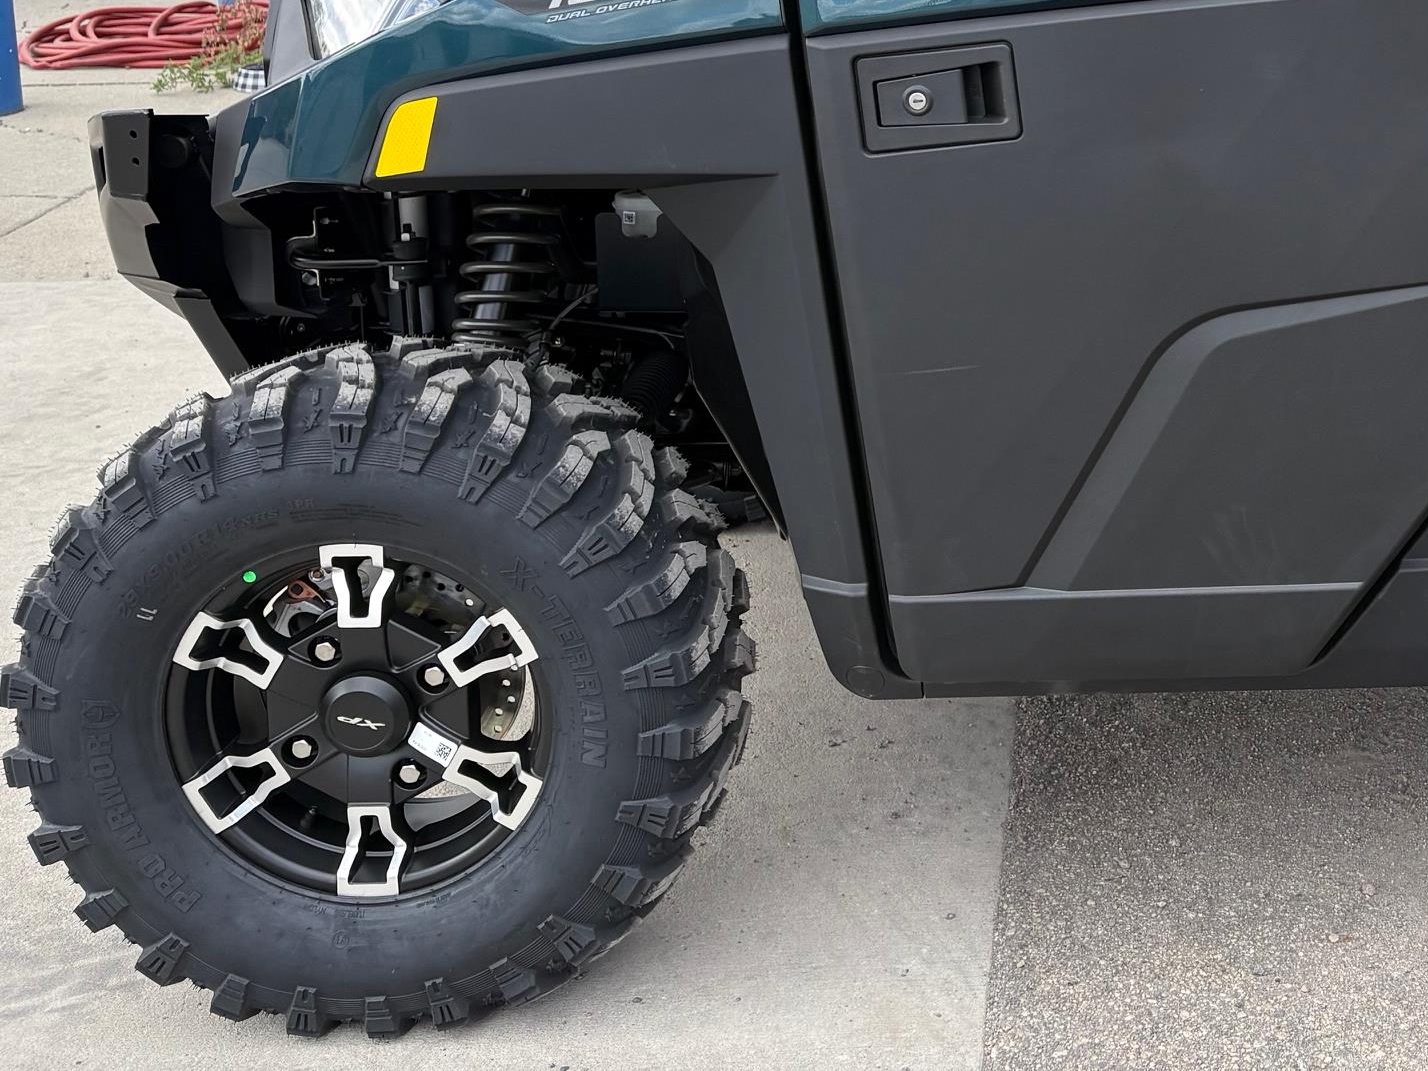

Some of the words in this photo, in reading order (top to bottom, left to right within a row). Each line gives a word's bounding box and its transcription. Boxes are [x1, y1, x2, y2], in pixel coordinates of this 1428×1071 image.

[547, 9, 590, 24] DUAL
[500, 555, 608, 769] X-TERRAIN
[336, 716, 386, 731] XP
[88, 733, 150, 850] ARMOR
[137, 853, 200, 913] PRO
